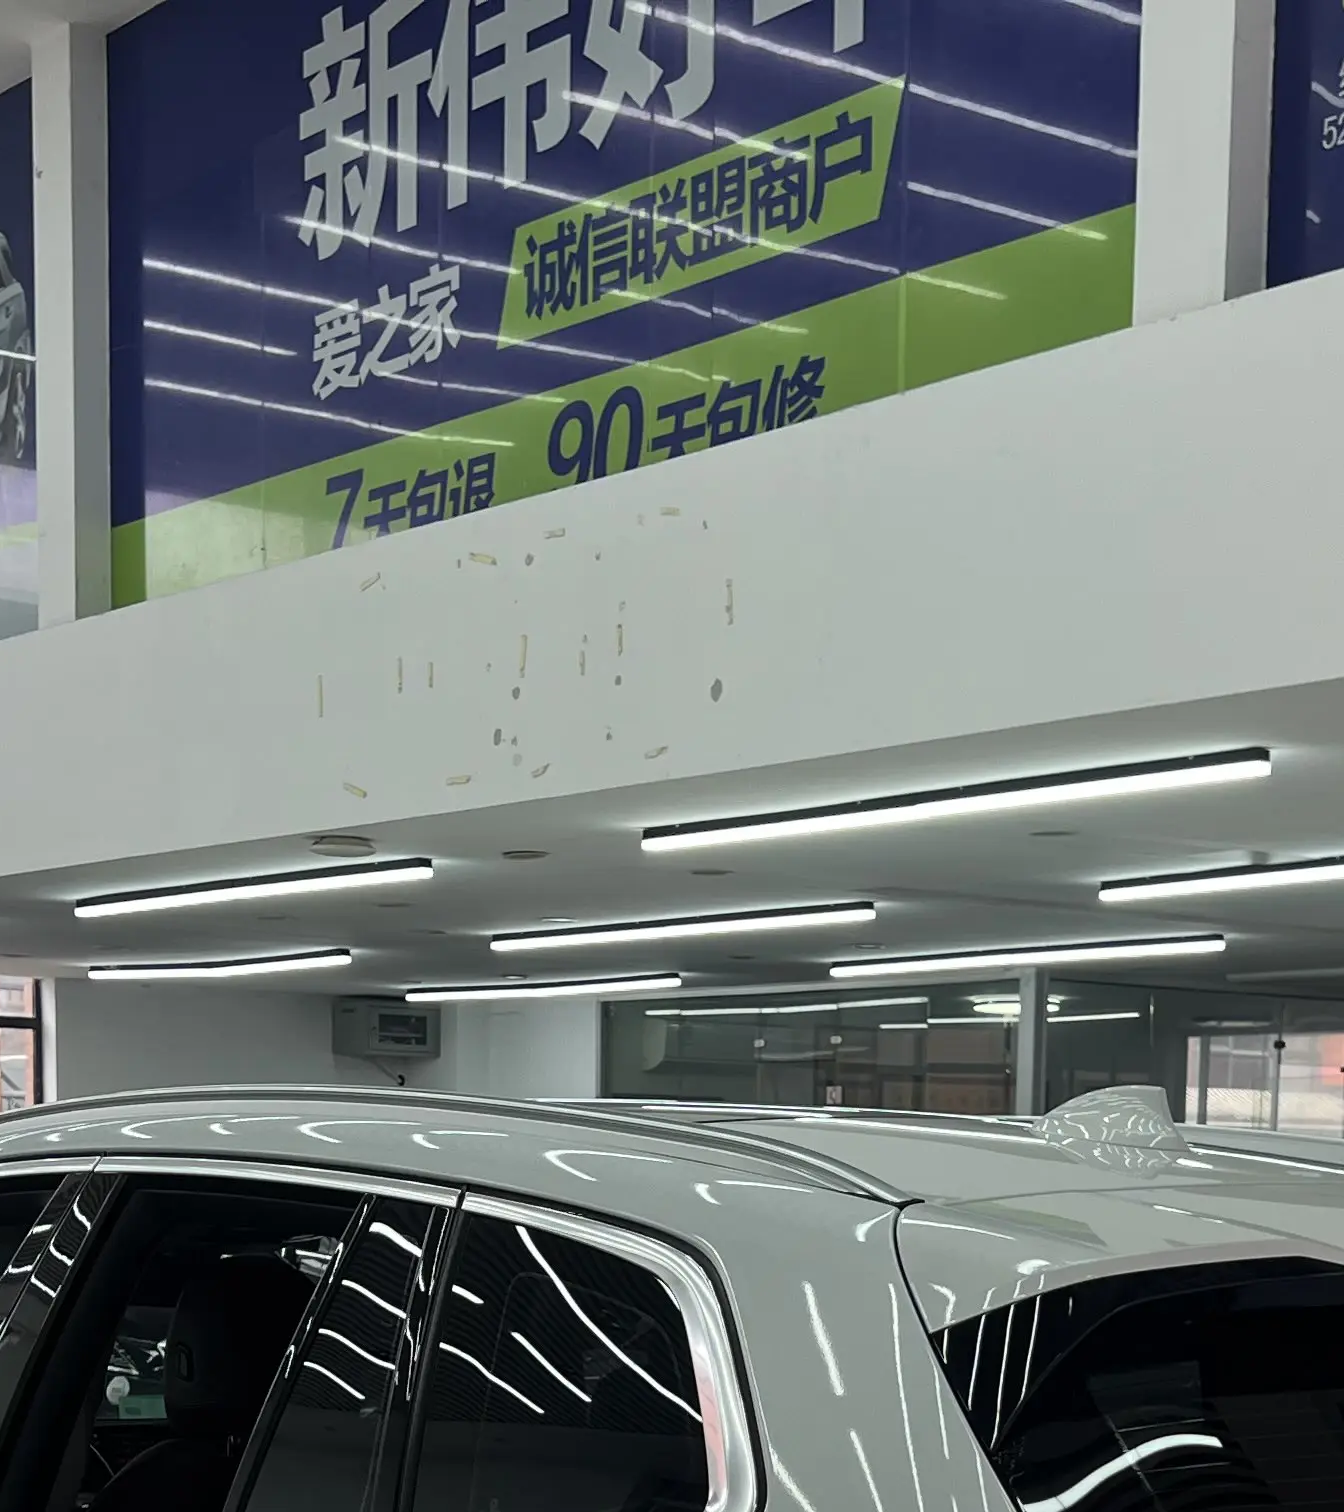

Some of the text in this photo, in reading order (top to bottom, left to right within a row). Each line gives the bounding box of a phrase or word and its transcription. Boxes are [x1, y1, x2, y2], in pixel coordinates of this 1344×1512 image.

[298, 0, 864, 261] 新伟好
[524, 111, 873, 320] 诚信联盟商户
[312, 263, 459, 402] 爱之家
